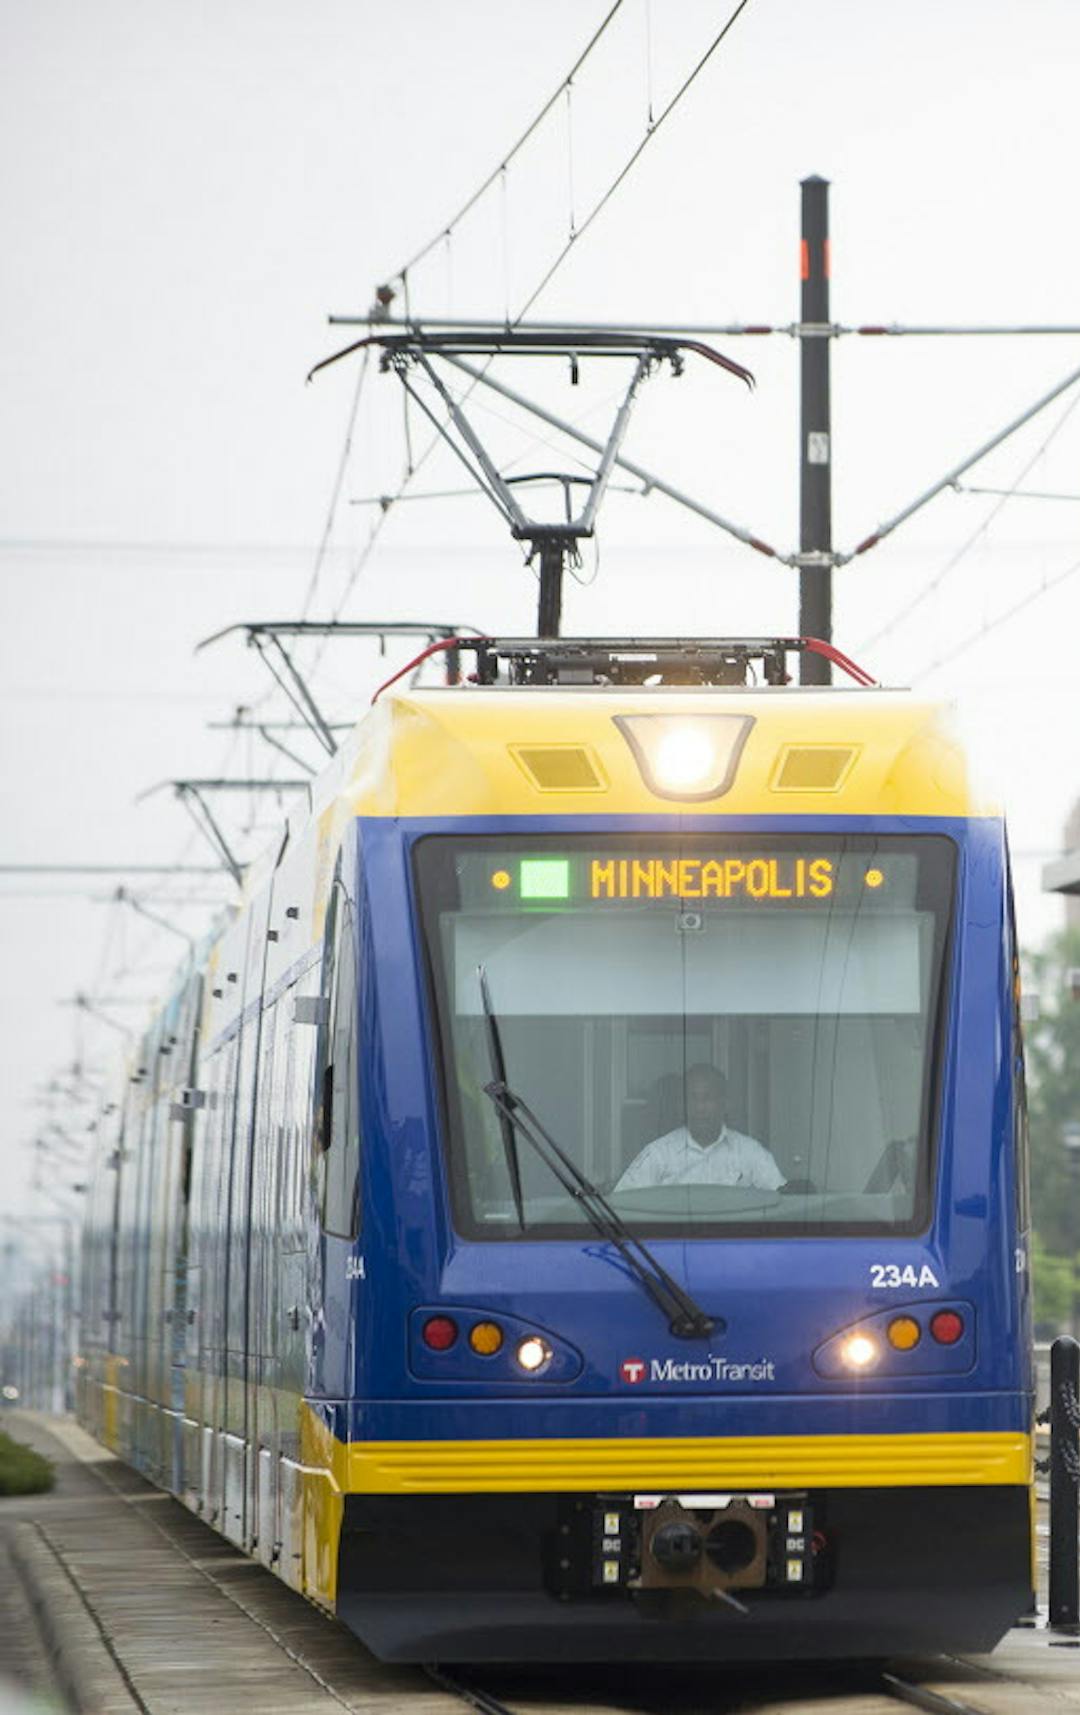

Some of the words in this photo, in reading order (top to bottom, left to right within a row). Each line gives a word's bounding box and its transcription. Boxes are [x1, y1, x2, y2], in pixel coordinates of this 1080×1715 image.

[591, 859, 832, 897] MINNEAPOLIS
[870, 1264, 940, 1288] 234A
[602, 1538, 622, 1553] DC
[786, 1537, 805, 1552] DC
